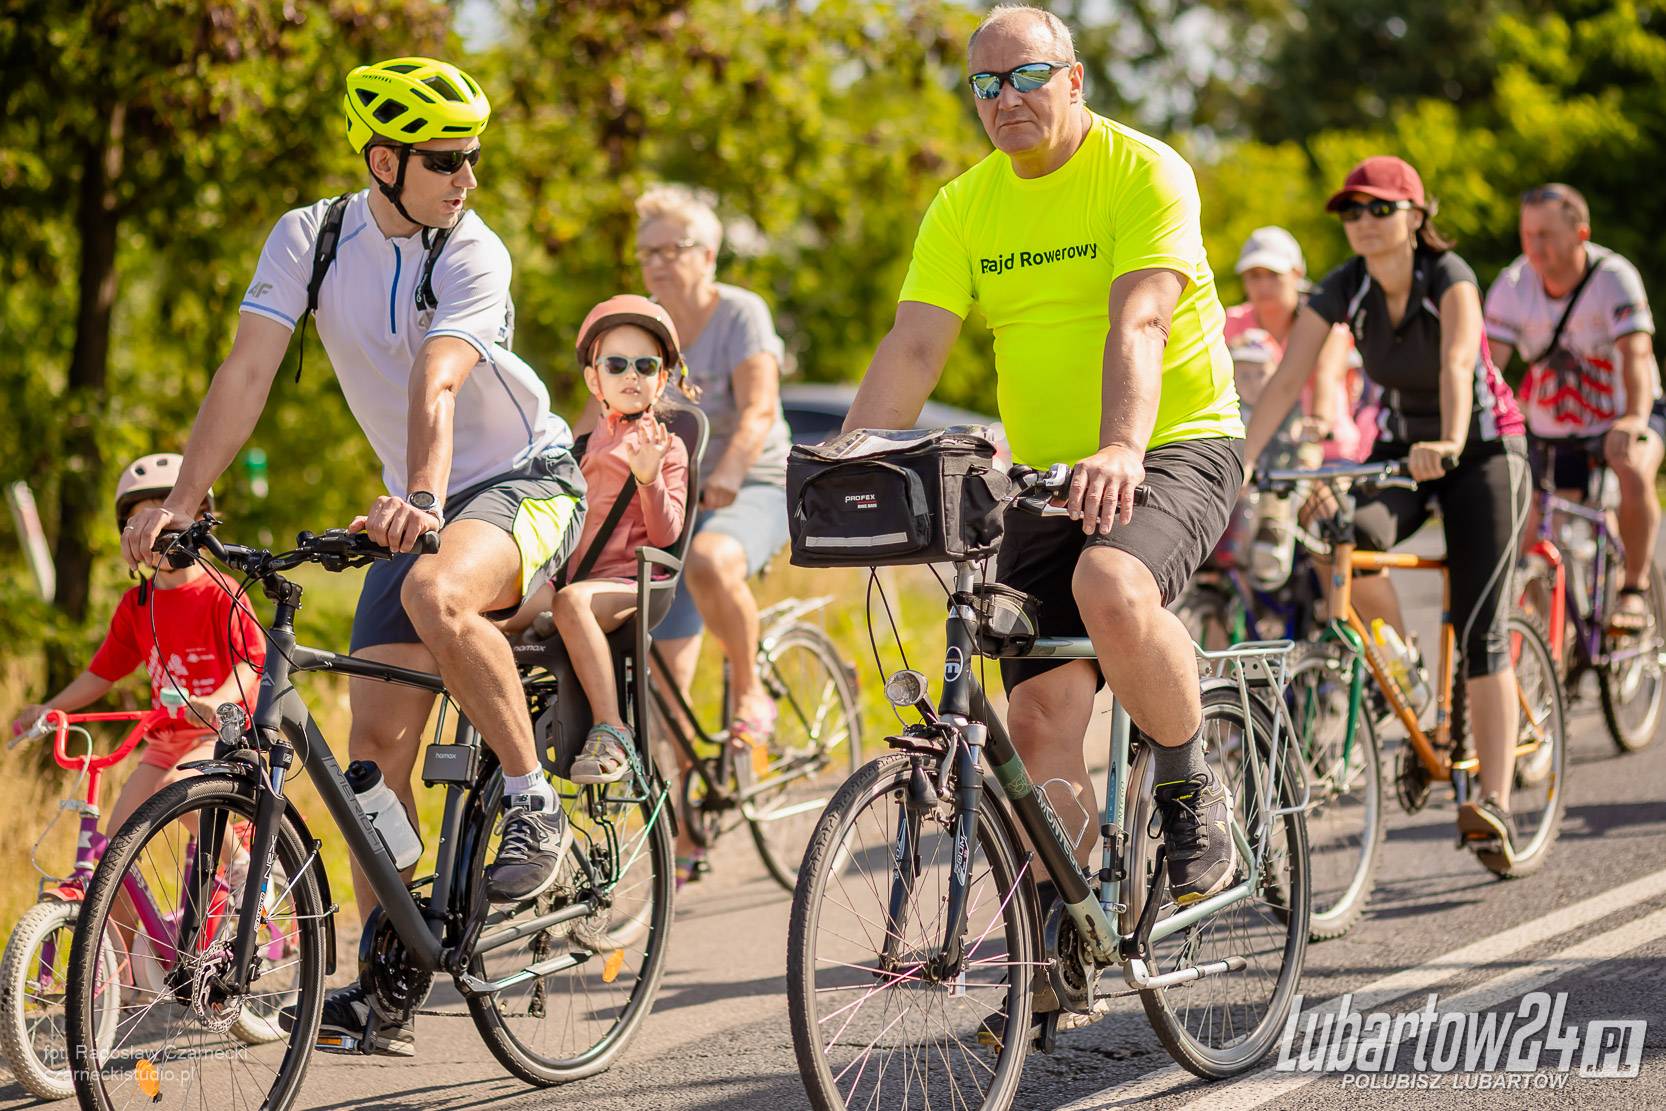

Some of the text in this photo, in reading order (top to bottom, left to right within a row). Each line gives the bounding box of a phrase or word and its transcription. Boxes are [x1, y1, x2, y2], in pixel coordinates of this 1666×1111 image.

[980, 242, 1097, 275] Rajd Rowerowy
[844, 494, 875, 503] PROFEX
